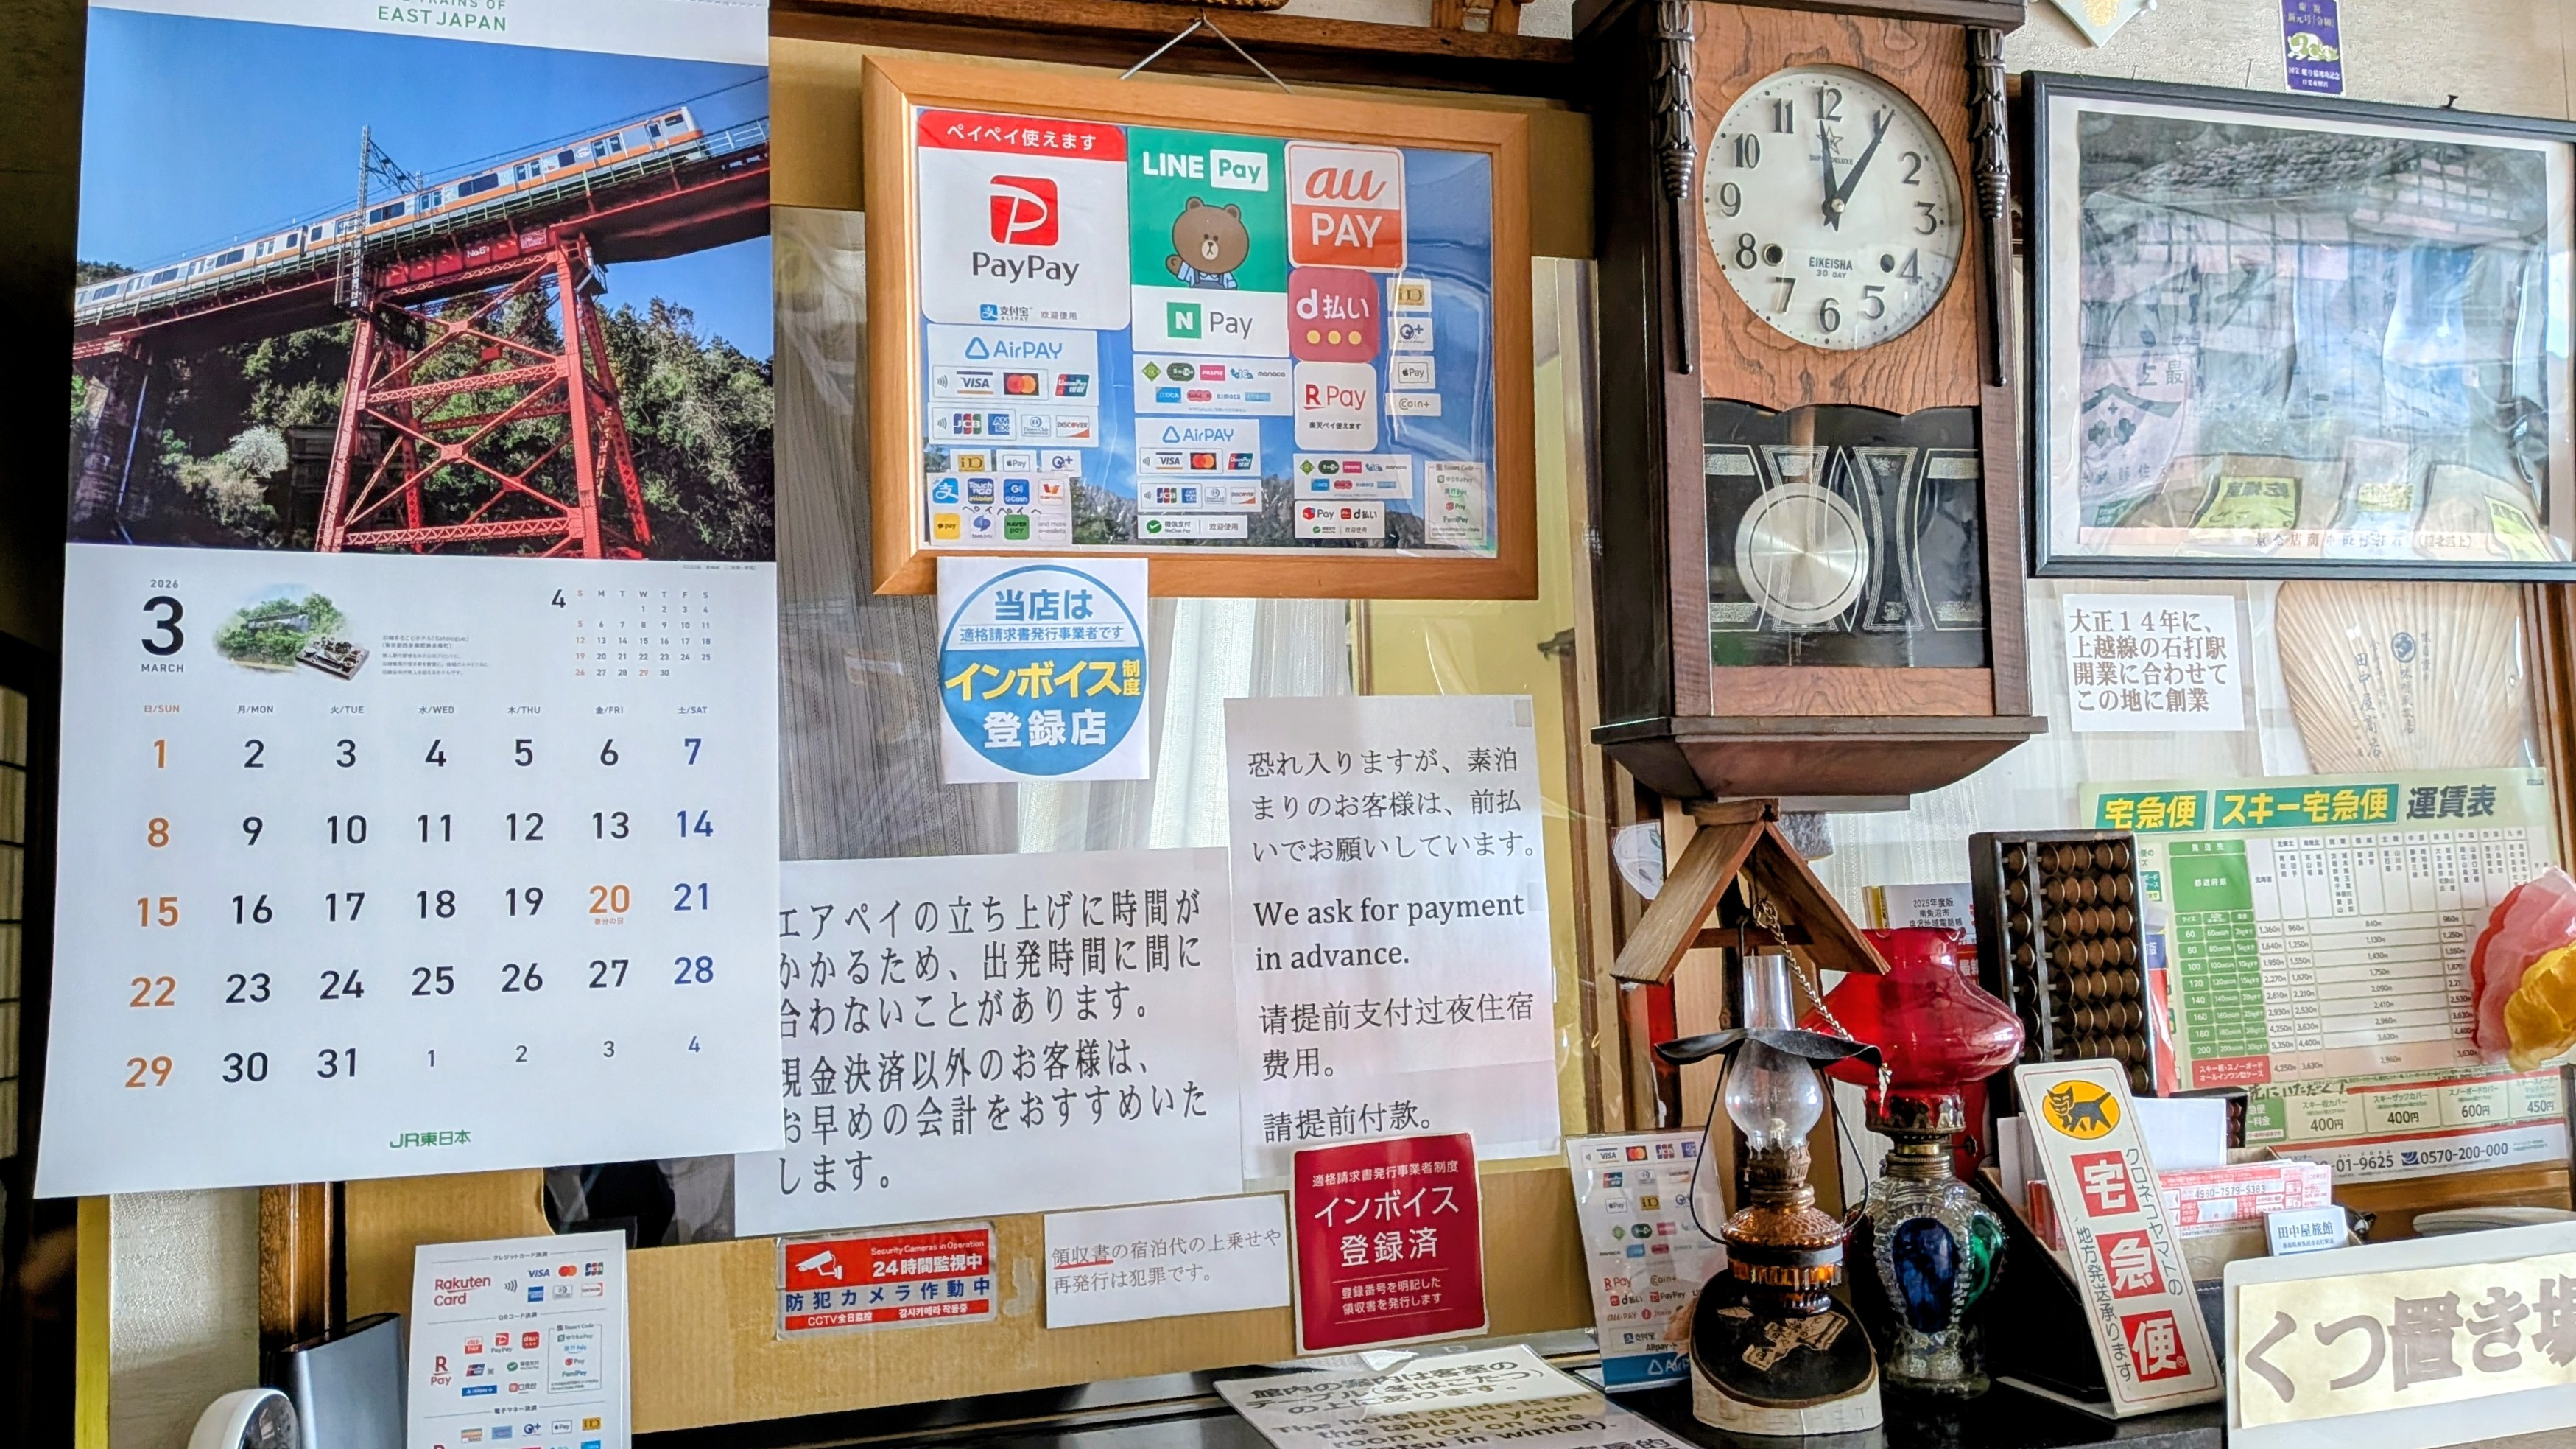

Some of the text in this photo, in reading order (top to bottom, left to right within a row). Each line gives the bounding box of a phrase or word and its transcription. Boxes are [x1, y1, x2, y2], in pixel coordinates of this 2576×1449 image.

[378, 6, 506, 32] EAST JAPAN
[1773, 98, 1795, 134] 11
[1817, 86, 1843, 122] 12
[947, 124, 1096, 150] ペイペイ使えます
[1734, 133, 1761, 169] 10
[1143, 152, 1261, 184] LINE Pay
[1901, 151, 1922, 185] 2
[1305, 167, 1386, 202] au
[1720, 182, 1741, 217] 9
[1312, 213, 1382, 248] PAY
[1915, 202, 1937, 235] 3
[1736, 233, 1757, 270] 8
[1809, 256, 1853, 270] EIKEISHA
[1900, 248, 1922, 285] 4
[972, 251, 1080, 286] PayPay
[1296, 288, 1369, 320] d払い
[1775, 277, 1796, 314] 7
[1864, 285, 1885, 320] 5
[1041, 311, 1077, 320] 欢迎使用
[1210, 311, 1252, 339] Pay
[1820, 297, 1840, 332] 6
[994, 340, 1062, 359] AirPAY
[960, 377, 989, 388] VISA
[1409, 368, 1424, 377] Pay
[1327, 386, 1366, 410] Pay
[1399, 398, 1429, 410] Coin+
[1183, 428, 1234, 441] AirPAY
[152, 580, 179, 589] 2026
[552, 590, 566, 608] 4
[995, 589, 1093, 621] 当店は
[143, 597, 184, 656] 3
[960, 626, 1124, 642] 適格請求書発行事業者です
[2072, 634, 2228, 660] 上越線の石打駅
[141, 664, 186, 673] MARCH
[945, 659, 1141, 701] インボイス 制度
[2073, 661, 2227, 687] 開業に合わせて
[238, 706, 275, 715] 月/MON
[331, 706, 365, 715] 火/TUE
[420, 706, 456, 715] 水/WED
[508, 706, 541, 715] 木/THU
[596, 706, 624, 715] 金/FRI
[679, 706, 708, 715] 土/SAT
[2077, 687, 2209, 713] この地に創業
[984, 708, 1106, 748] 登録店
[155, 740, 702, 769] 1 2 3 4 5 6 7
[1247, 746, 1519, 779] 恐れ入りますが、素泊
[1252, 788, 1522, 821] まりのお客様は、前払
[2105, 785, 2496, 829] 宅急便 スキー宅急便 運賃表
[1253, 829, 1535, 863] いでお願いしています。
[138, 884, 711, 927] 15 16 17 18 19 20 21
[779, 888, 1200, 938] エアペイの立ち上げに時間が
[1253, 893, 1525, 927] We ask for payment
[1913, 898, 1954, 908] 2025年度版
[781, 933, 1202, 988] かかるため、出発時間に間に
[1256, 943, 1410, 972] in advance.
[131, 957, 714, 1008] 22 23 24 25 26 27 28
[781, 980, 1147, 1039] 合わないことがあります。
[1259, 990, 1535, 1036] 请提前支付过夜住宿
[2194, 1013, 2207, 1021] 160
[126, 1049, 359, 1088] 29 30 31
[782, 1037, 1149, 1098] 現金決済以外のお客様は、
[1261, 1048, 1334, 1081] 费用。
[2373, 1085, 2499, 1104] スキーザックカバー スノーボードカバー
[785, 1079, 1207, 1145] お早めの会計をおすすめいた
[1262, 1100, 1432, 1144] 請提前付款。
[2310, 1100, 2554, 1132] 400円 400円 600円 450円
[390, 1131, 471, 1148] JR東日本
[2421, 1143, 2508, 1165] 0570-200-000
[780, 1149, 890, 1196] します。
[1312, 1159, 1459, 1187] 適格請求書発行事業者制度
[1314, 1185, 1460, 1228] インボイス
[2125, 1147, 2183, 1297] クロネコヤマトの
[2278, 1221, 2333, 1239] 田中屋旅館
[871, 1247, 903, 1255] Security
[904, 1244, 937, 1253] Cameras
[947, 1241, 984, 1249] Operation
[1052, 1228, 1282, 1269] 領収書の宿泊代の上乗せや
[1340, 1227, 1437, 1267] 登録済
[527, 1269, 550, 1277] VISA
[873, 1253, 982, 1277] 24時間監視中
[1053, 1264, 1215, 1295] 再発行は犯罪です。
[2082, 1159, 2180, 1376] 宅急便
[434, 1275, 490, 1291] Rakuten
[786, 1277, 990, 1312] 防犯カメラ作動中
[1342, 1277, 1441, 1299] 登録番号を明記した
[434, 1293, 467, 1306] Card
[899, 1306, 940, 1319] 감시카메라
[1342, 1292, 1442, 1316] 領収書を発行します
[2076, 1225, 2133, 1383] 地方発送承ります
[1287, 1383, 1518, 1414] の上にあります。
[1339, 1392, 1591, 1426] hotel on
[1507, 1404, 1572, 1419] your
[1533, 1412, 1585, 1425] the
